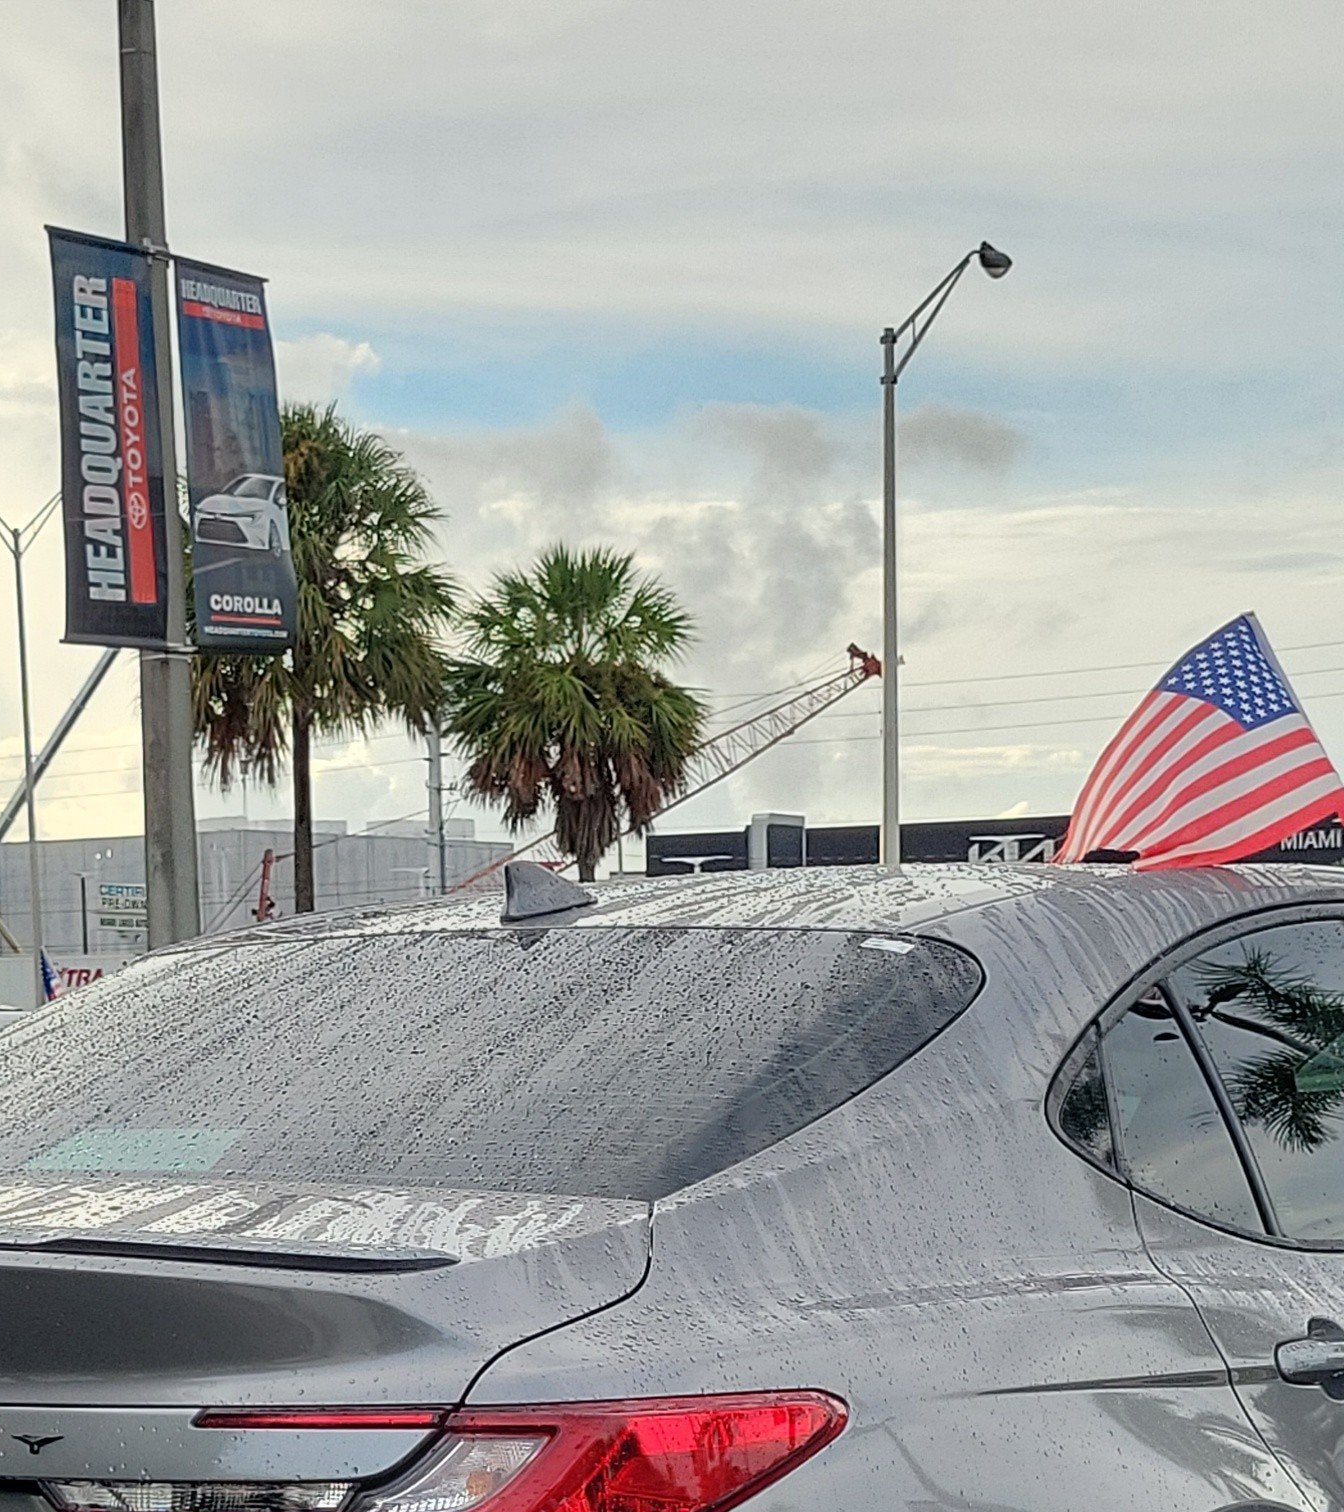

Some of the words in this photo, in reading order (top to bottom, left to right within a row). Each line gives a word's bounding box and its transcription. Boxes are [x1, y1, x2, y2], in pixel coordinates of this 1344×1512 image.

[181, 279, 262, 315] HEADQUARTER
[73, 274, 126, 601] HEADQUARTER
[122, 368, 143, 487] TOYOTA
[209, 594, 282, 615] COROLLA
[1280, 829, 1343, 851] MIAMI
